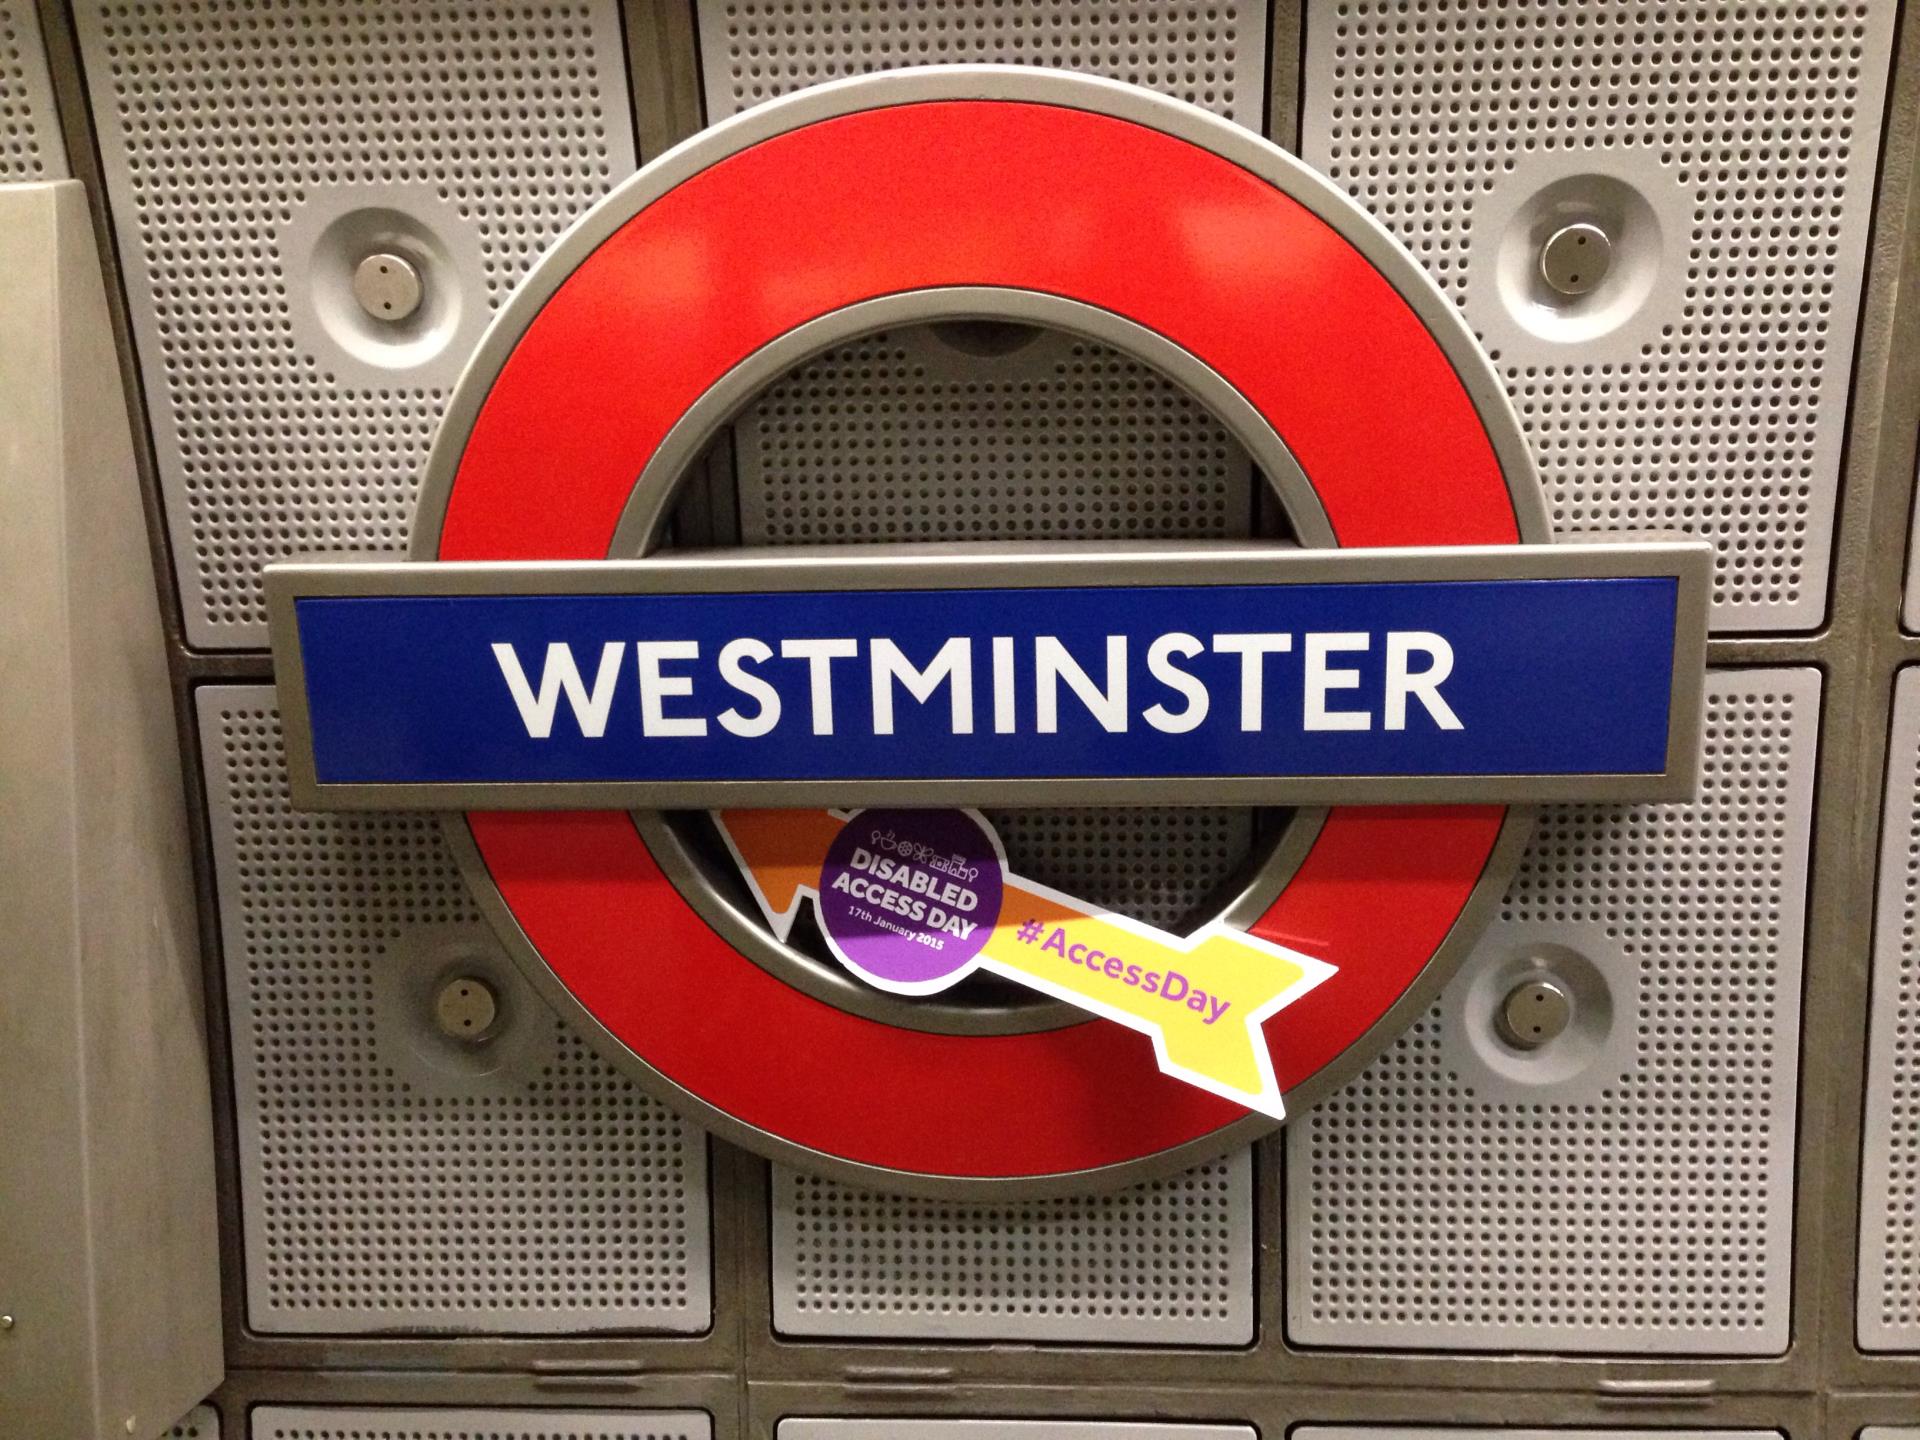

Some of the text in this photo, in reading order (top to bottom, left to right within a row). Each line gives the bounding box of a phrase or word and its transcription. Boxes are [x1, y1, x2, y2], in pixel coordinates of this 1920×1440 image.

[491, 632, 1465, 738] WESTMINSTER
[832, 872, 978, 941] ACCESS DAY
[850, 847, 978, 912] DISABLED
[848, 905, 945, 951] 17th January 2015
[1016, 918, 1232, 1025] #AccessDay
